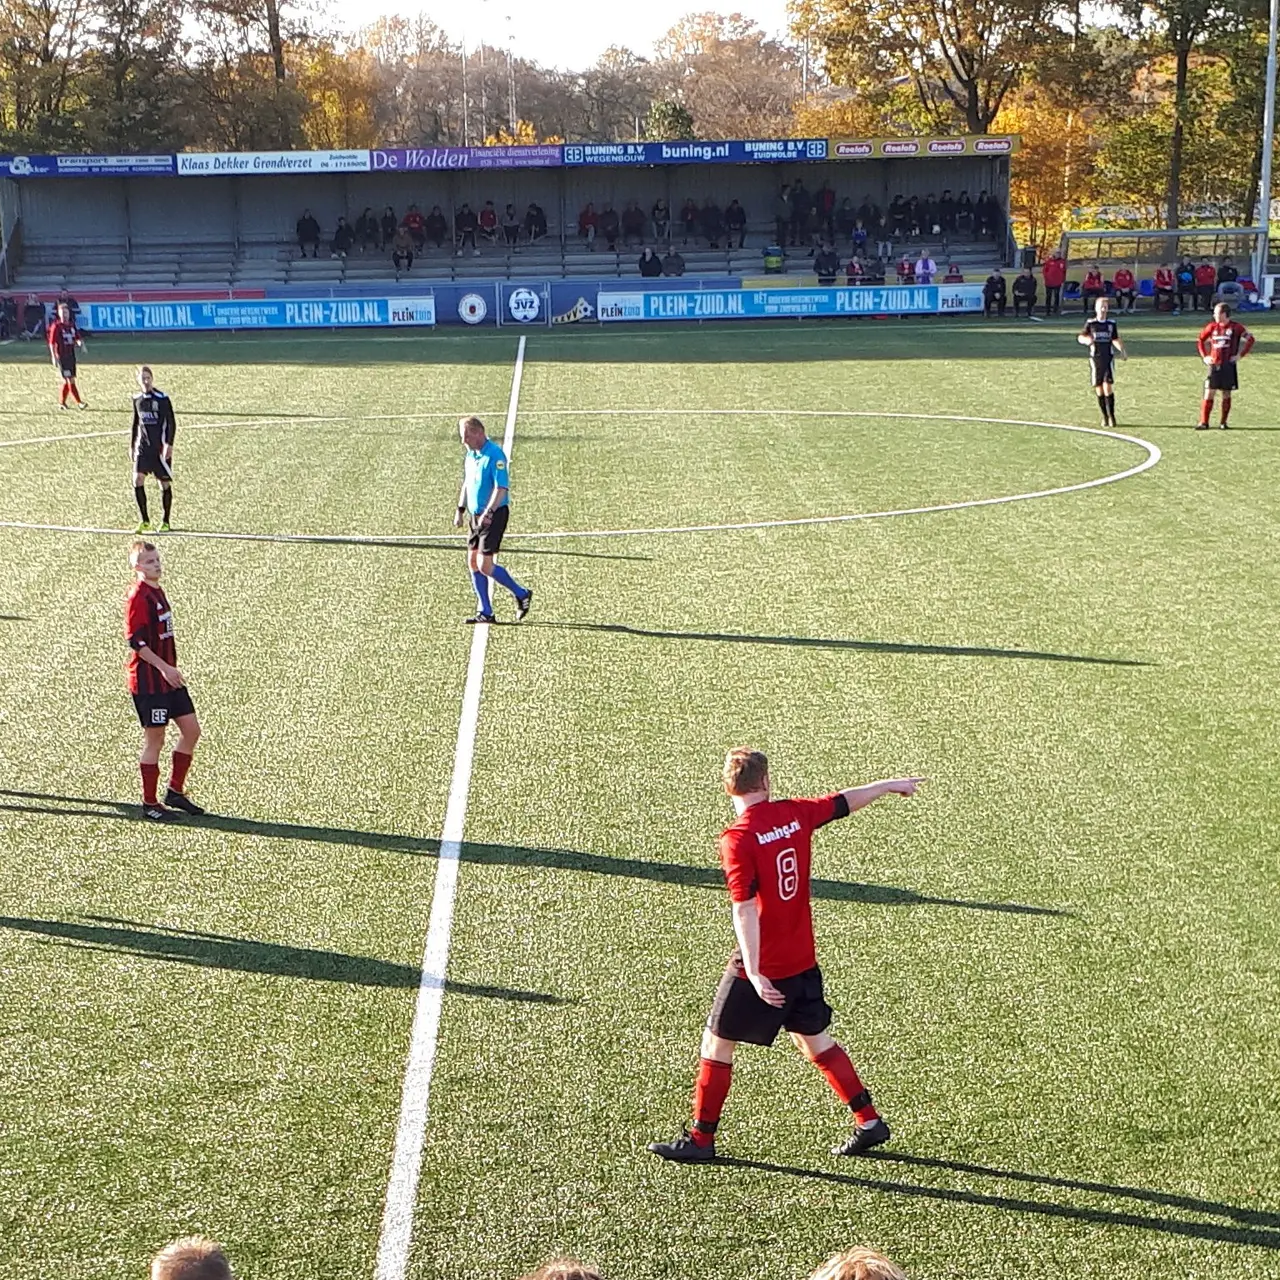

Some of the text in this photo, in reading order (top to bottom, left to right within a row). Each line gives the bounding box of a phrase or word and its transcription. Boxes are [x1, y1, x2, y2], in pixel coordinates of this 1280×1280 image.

[373, 149, 469, 169] De Wolden
[662, 143, 729, 159] buning.nl
[181, 157, 210, 171] Klaas
[213, 156, 250, 169] Dekker
[514, 300, 535, 310] JVZ
[651, 293, 745, 316] PLEIN-ZUID.NL
[836, 288, 931, 311] PLEIN-ZUID.NL
[98, 304, 195, 328] PLEIN-ZUID.NL
[286, 301, 382, 324] PLEIN-ZUID.NL
[776, 847, 799, 901] 8
